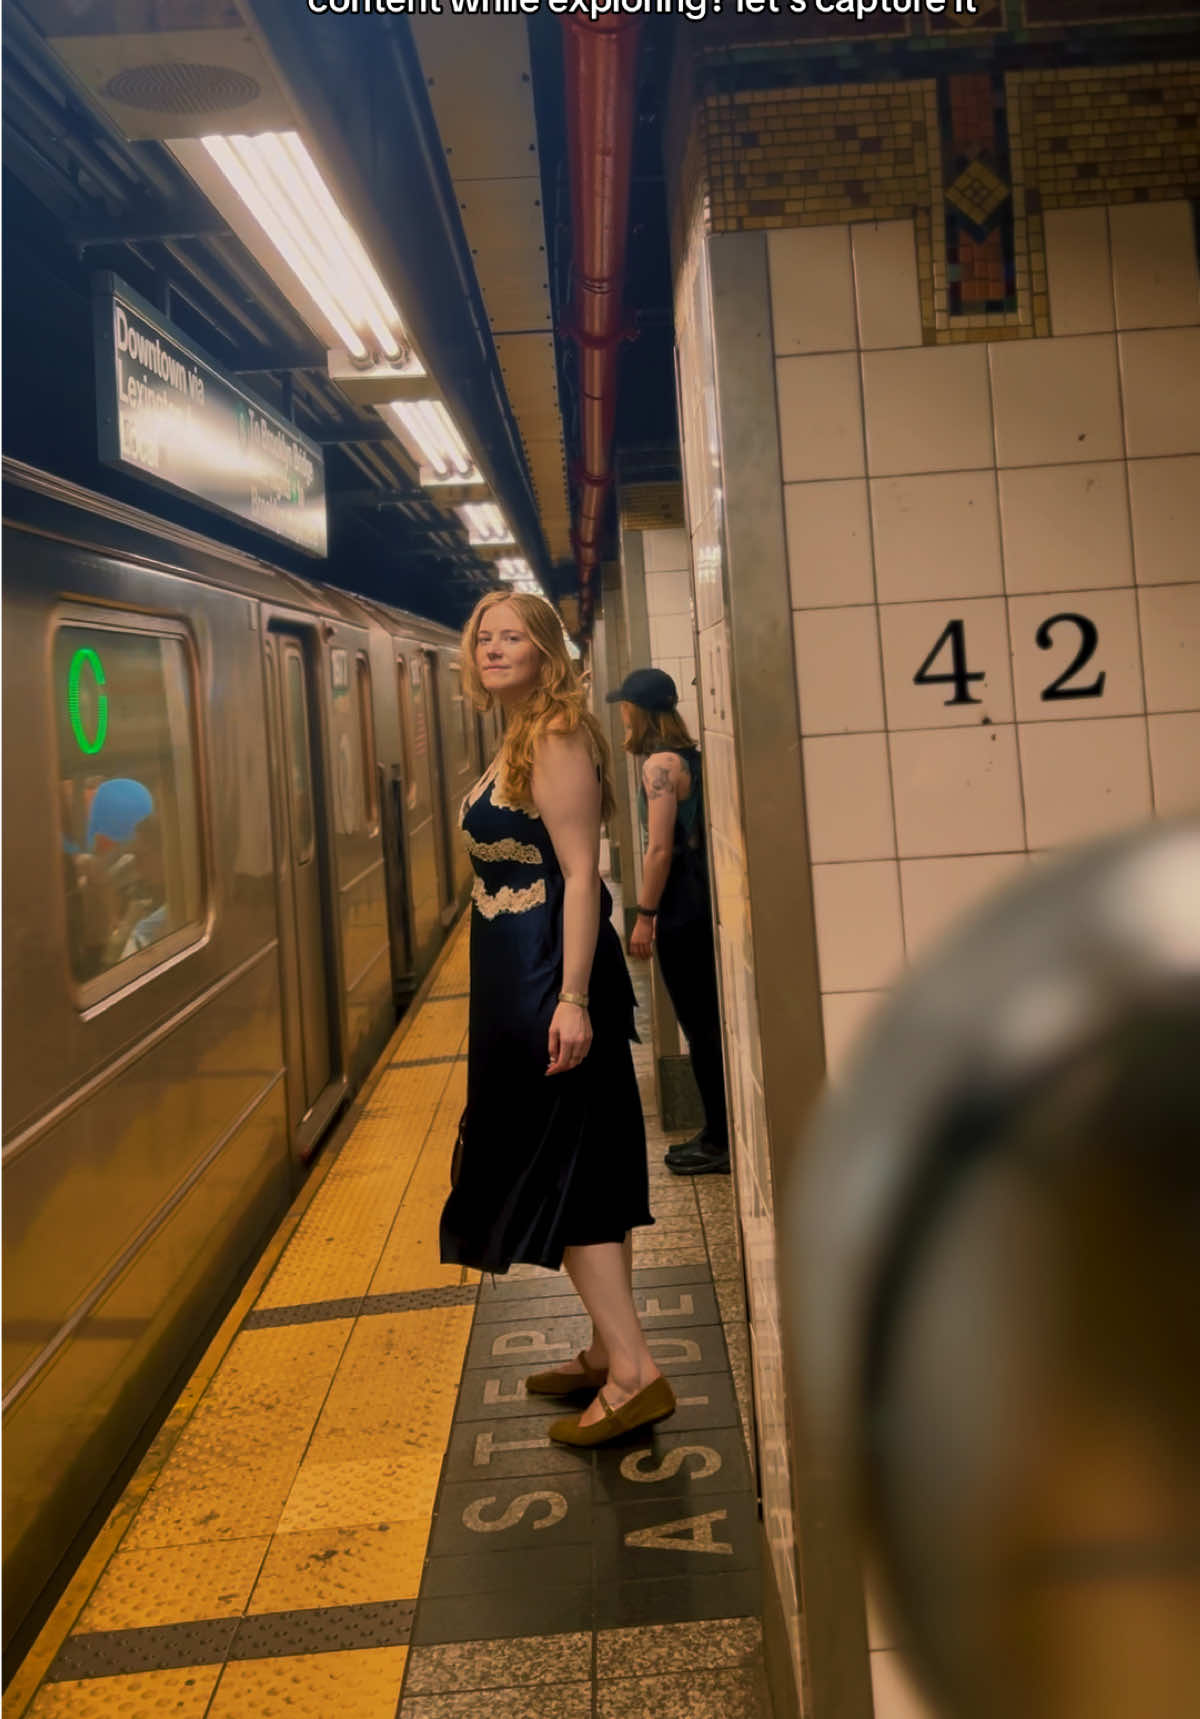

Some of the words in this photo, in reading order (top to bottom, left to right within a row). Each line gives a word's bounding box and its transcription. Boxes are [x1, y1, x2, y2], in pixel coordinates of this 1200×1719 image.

[115, 305, 188, 398] Downtown
[188, 366, 206, 406] via
[462, 1329, 571, 1533] STEP
